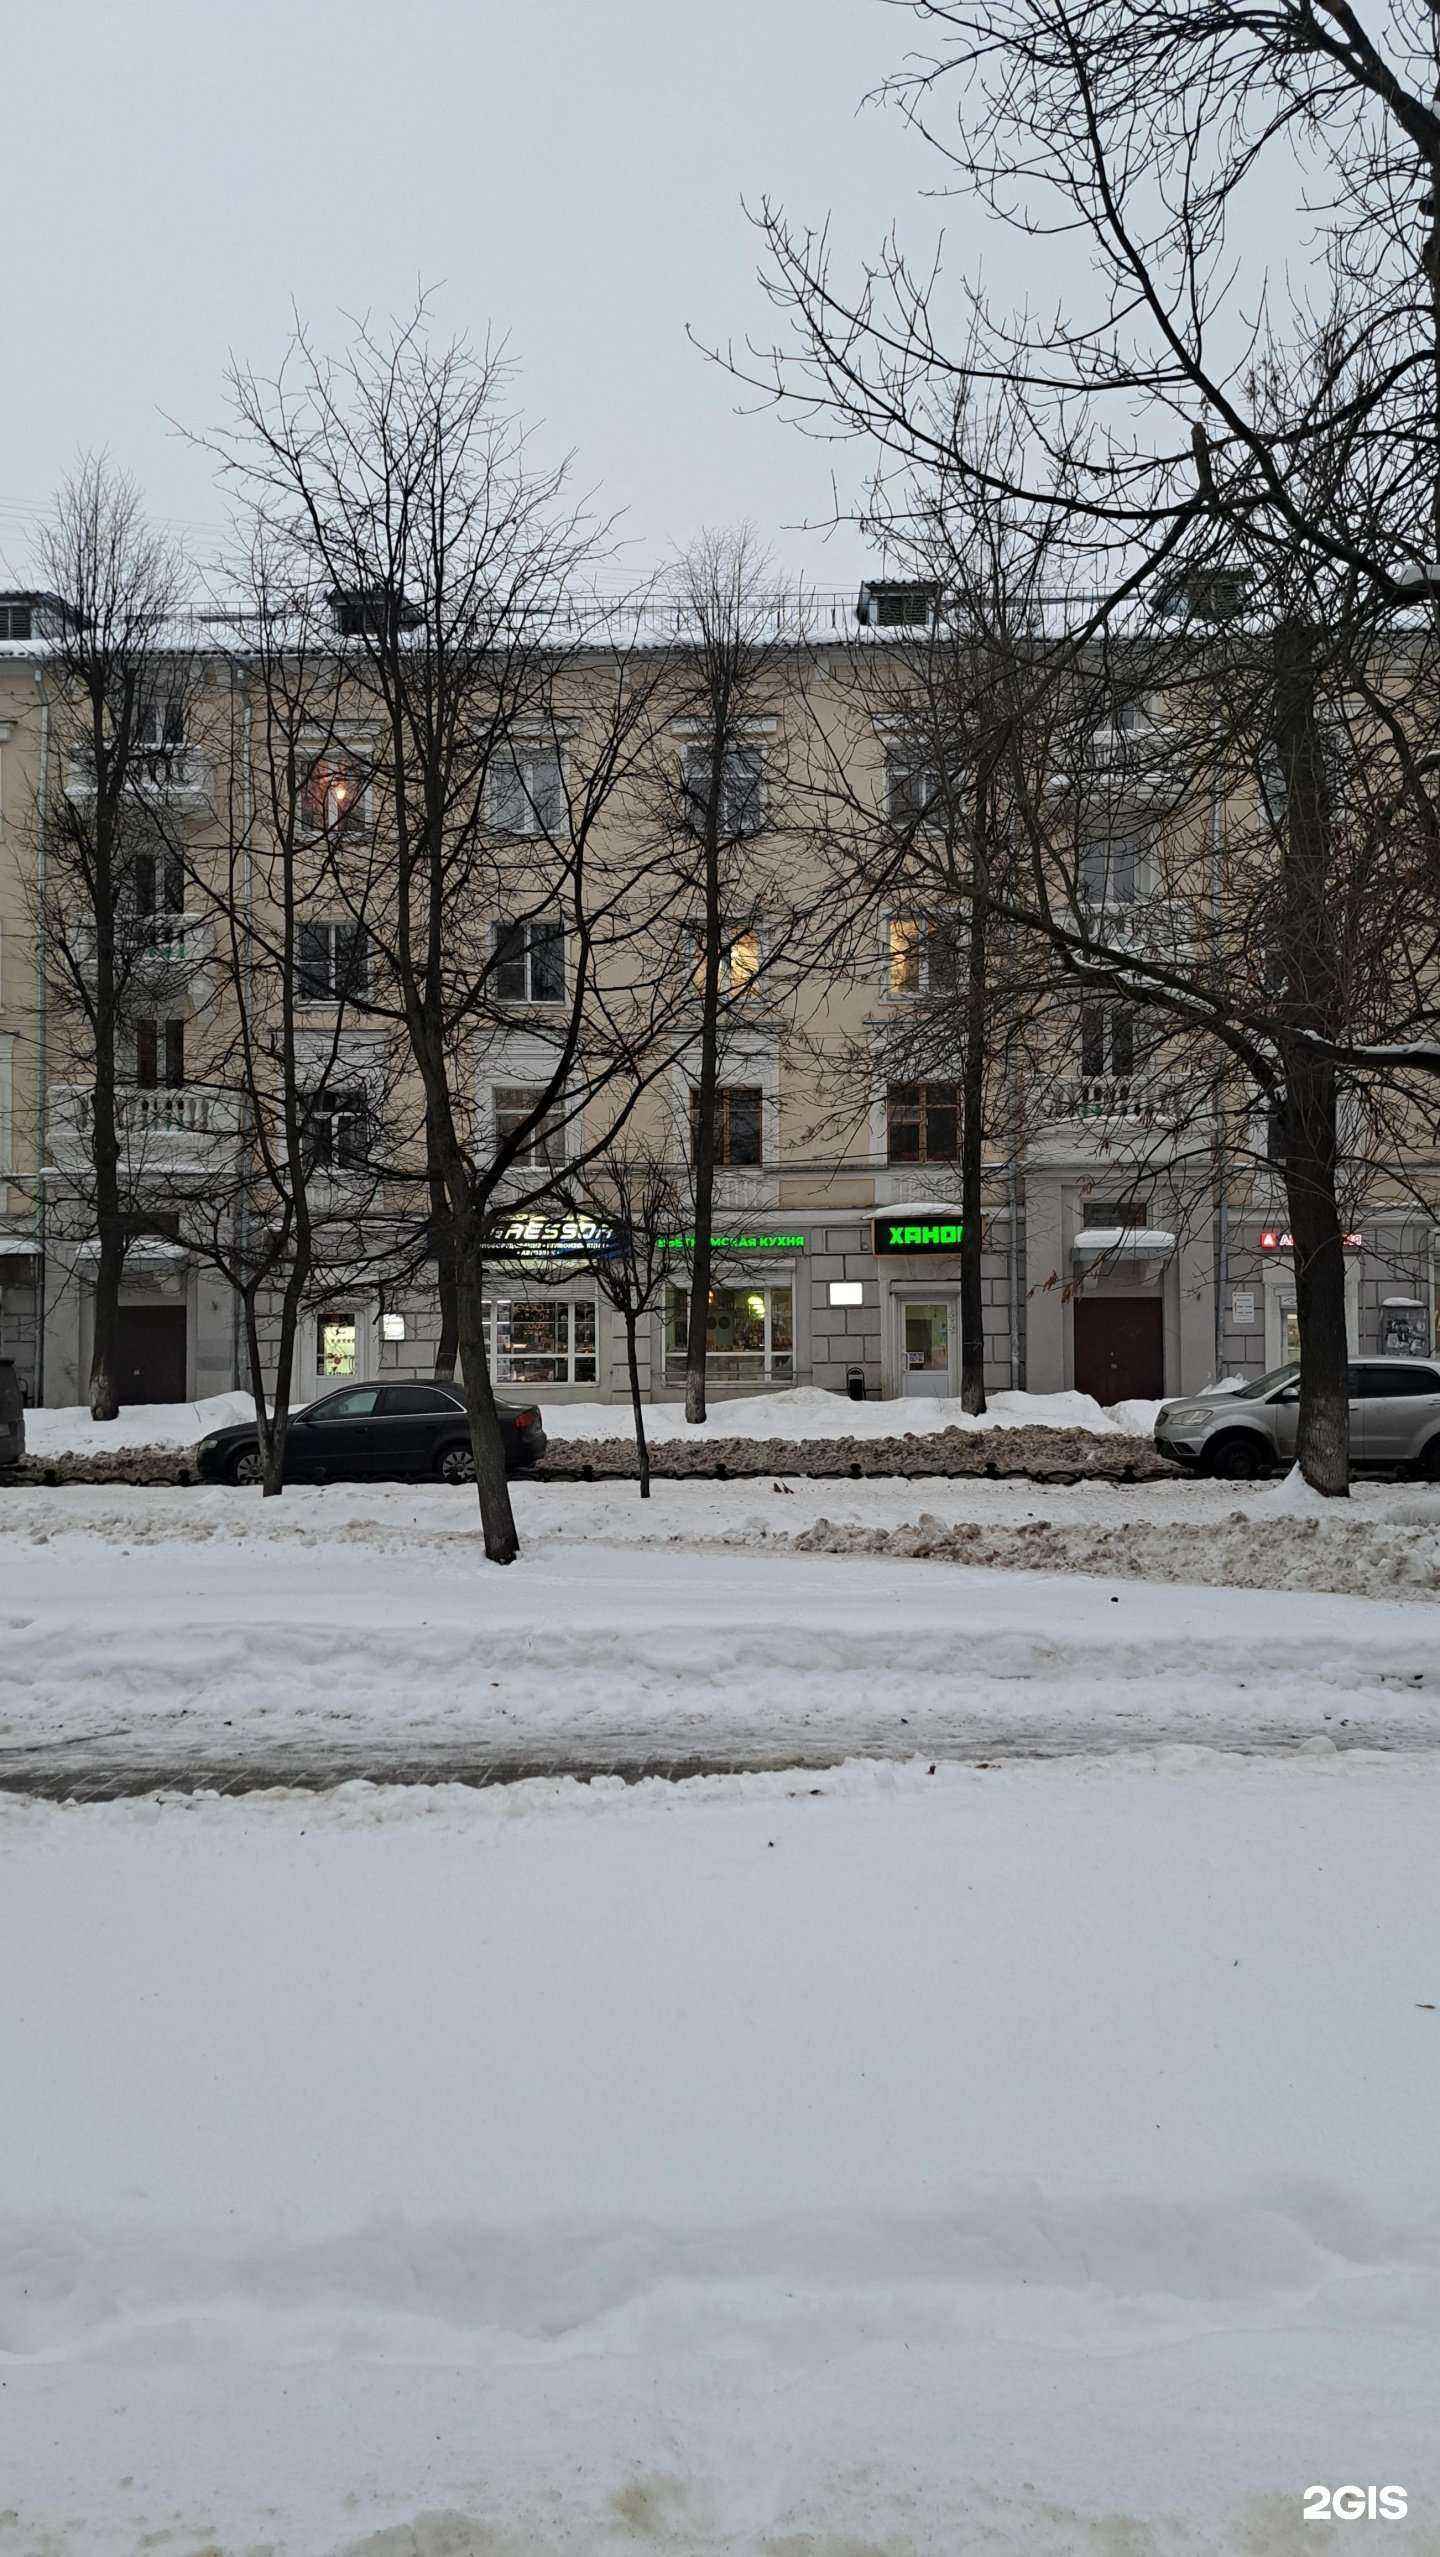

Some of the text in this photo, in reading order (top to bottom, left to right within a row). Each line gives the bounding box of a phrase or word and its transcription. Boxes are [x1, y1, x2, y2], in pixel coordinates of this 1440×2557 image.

[484, 1223, 613, 1240] GRESSOR
[657, 1236, 805, 1248] ВЬЕТМСКАЯ КУХНЯ
